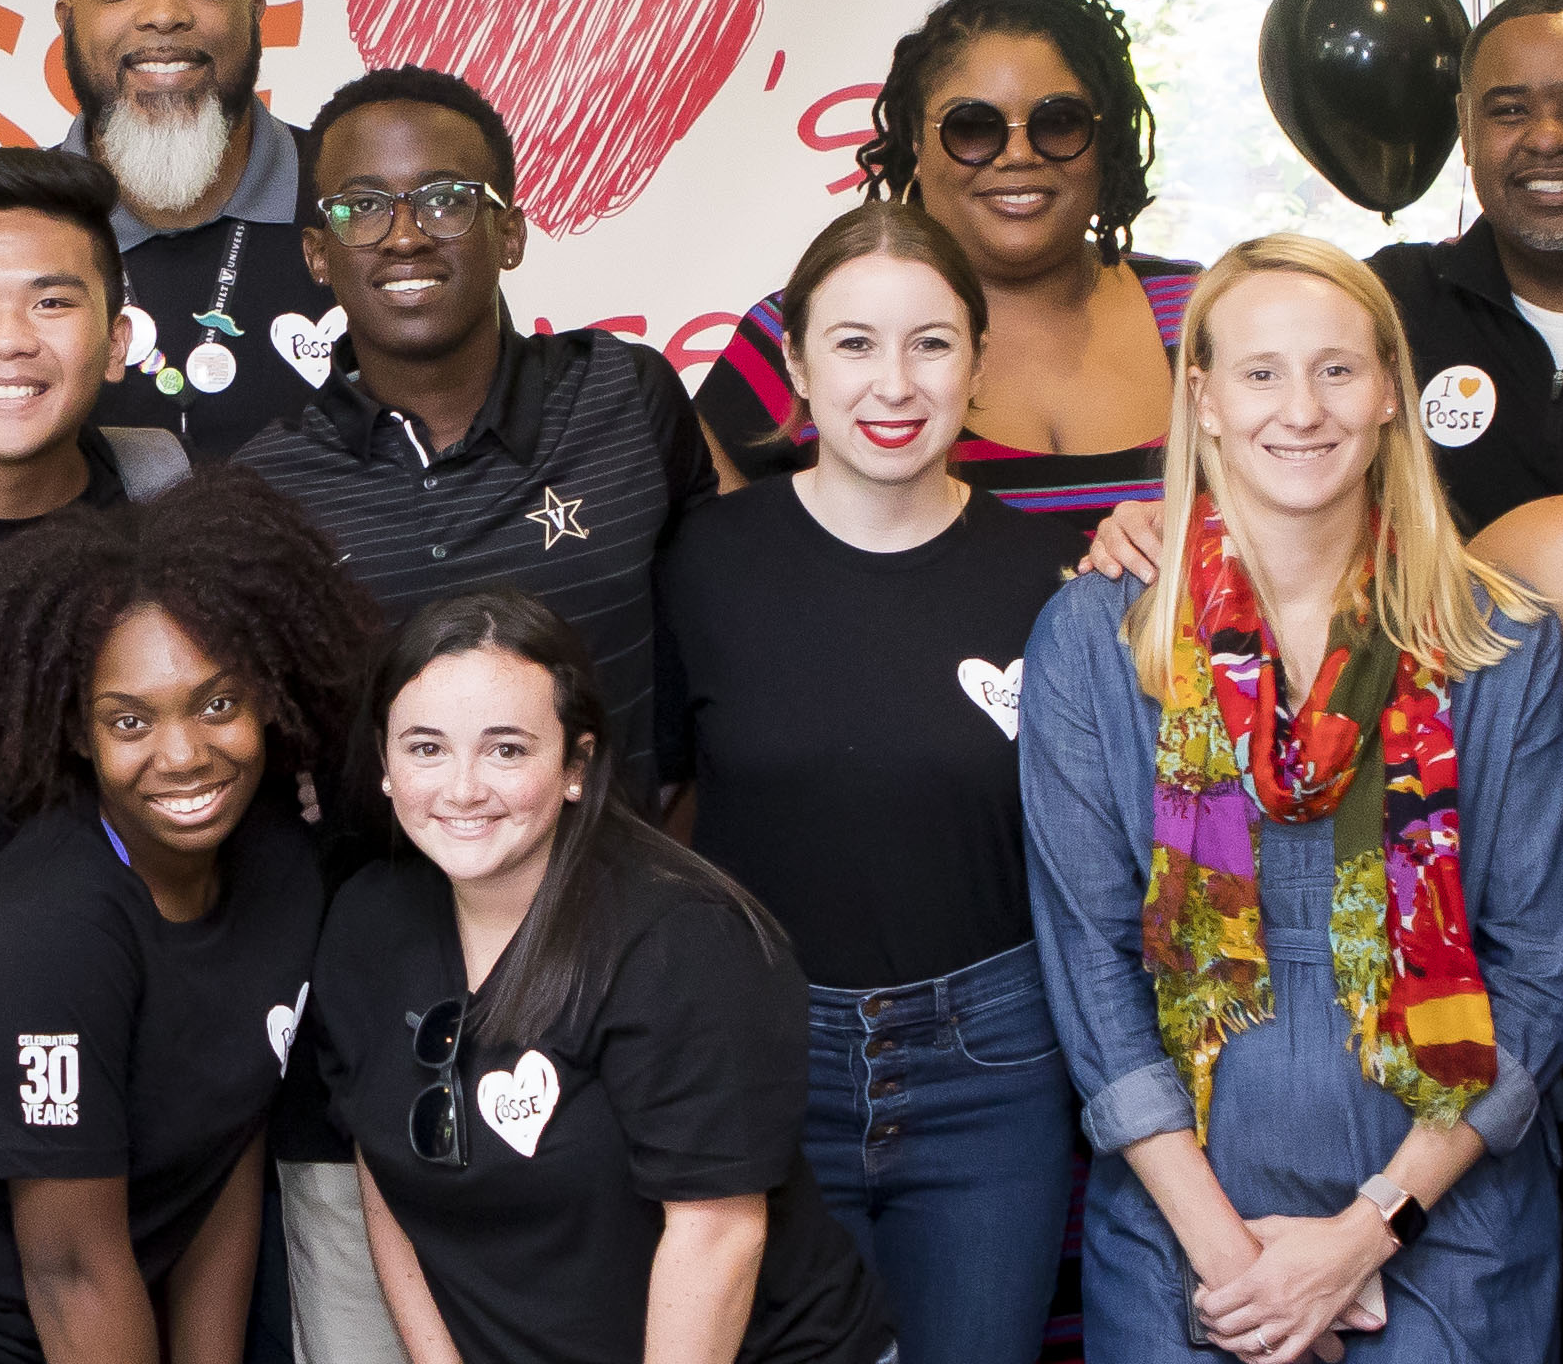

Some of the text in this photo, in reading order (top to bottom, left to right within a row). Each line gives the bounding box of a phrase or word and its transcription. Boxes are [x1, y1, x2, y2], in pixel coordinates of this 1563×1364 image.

[226, 221, 246, 269] UNIVERS
[291, 333, 332, 360] POSS
[1440, 375, 1454, 398] I
[980, 681, 1021, 710] POSS
[18, 1045, 79, 1106] 30
[21, 1102, 79, 1126] YEARS
